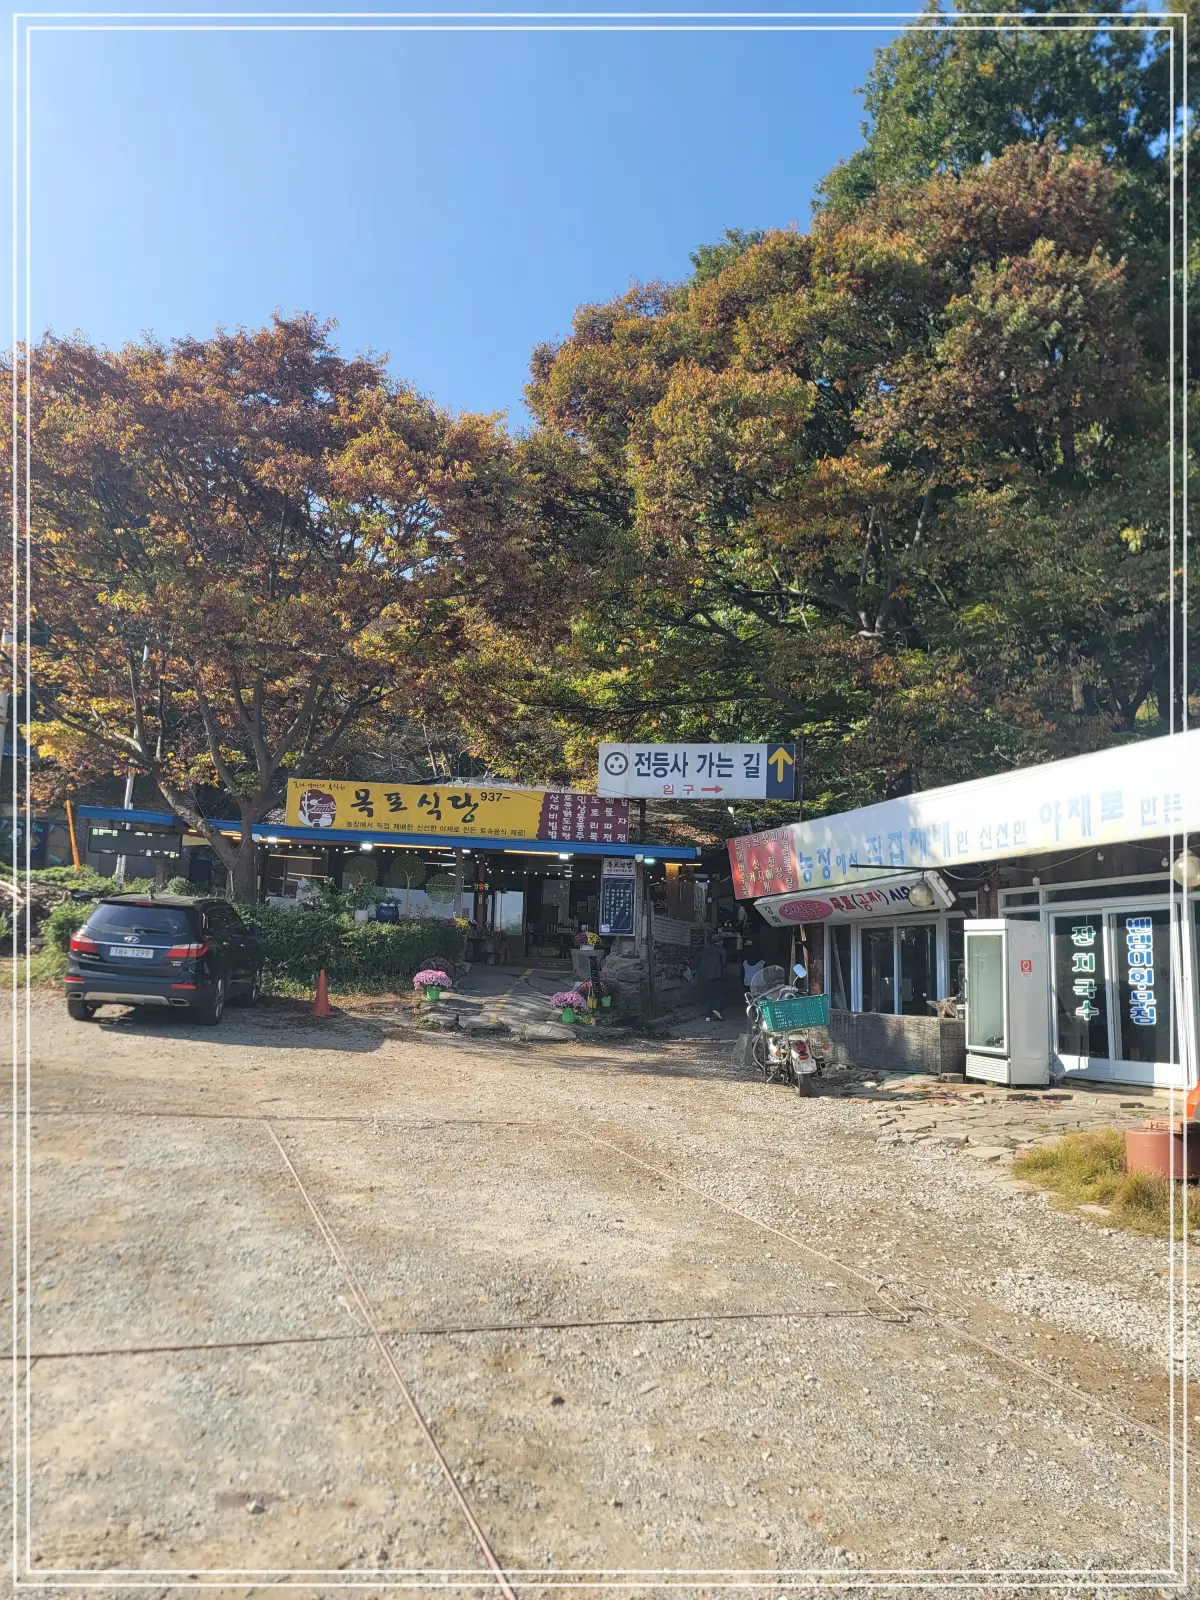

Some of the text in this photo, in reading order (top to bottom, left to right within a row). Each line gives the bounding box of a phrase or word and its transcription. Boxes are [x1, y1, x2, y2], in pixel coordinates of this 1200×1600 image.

[634, 751, 761, 779] 전등사 가는 길
[350, 788, 479, 823] 목포식당
[662, 784, 695, 795] 입구
[346, 820, 526, 837] 농장에서 직접 재배한 신선한 야채로 만든 토속음식 제공!
[547, 793, 560, 840] 산채비빔밥
[575, 795, 587, 841] 인삼동동주
[589, 796, 601, 842] 도토리묵
[798, 847, 859, 883] 농장에서
[980, 820, 1027, 850] 신선한
[1038, 789, 1124, 842] 야채로
[1140, 792, 1183, 827] 만든
[131, 949, 150, 958] 1299
[1071, 925, 1100, 1021] 잔치국수
